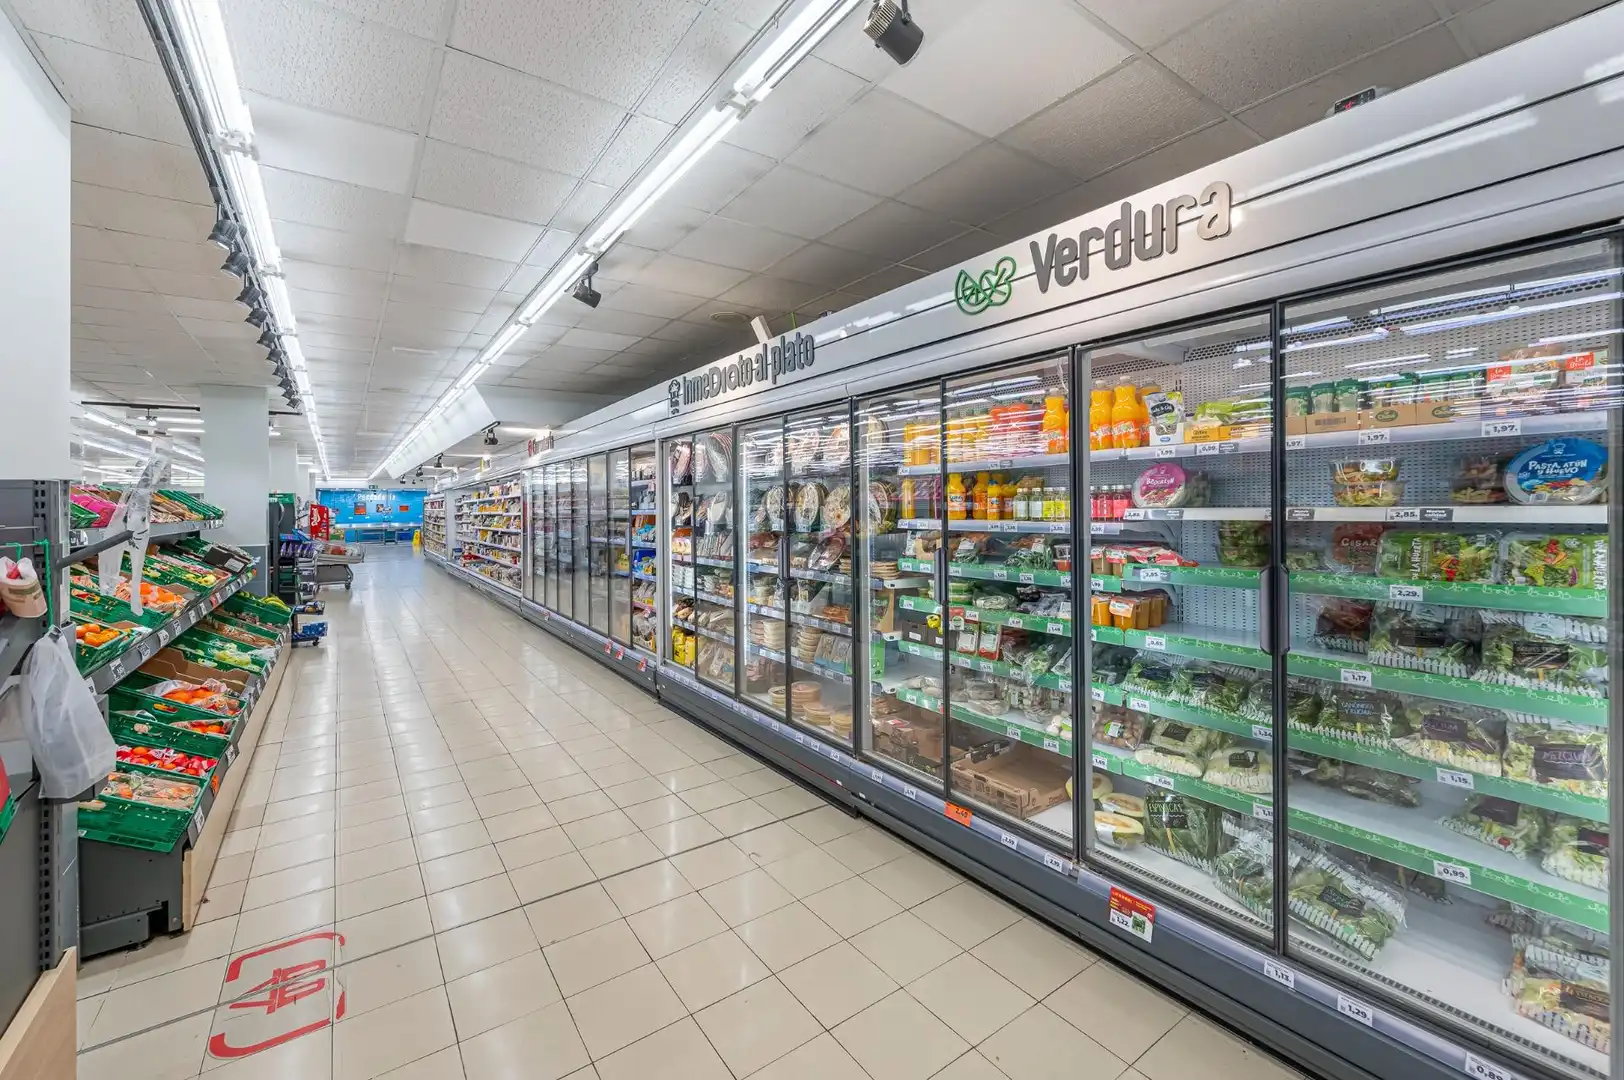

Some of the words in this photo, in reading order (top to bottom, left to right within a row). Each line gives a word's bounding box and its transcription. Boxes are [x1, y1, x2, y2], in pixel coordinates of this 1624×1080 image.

[1030, 181, 1231, 294] Verdura
[754, 343, 768, 382] al
[770, 332, 815, 385] plato
